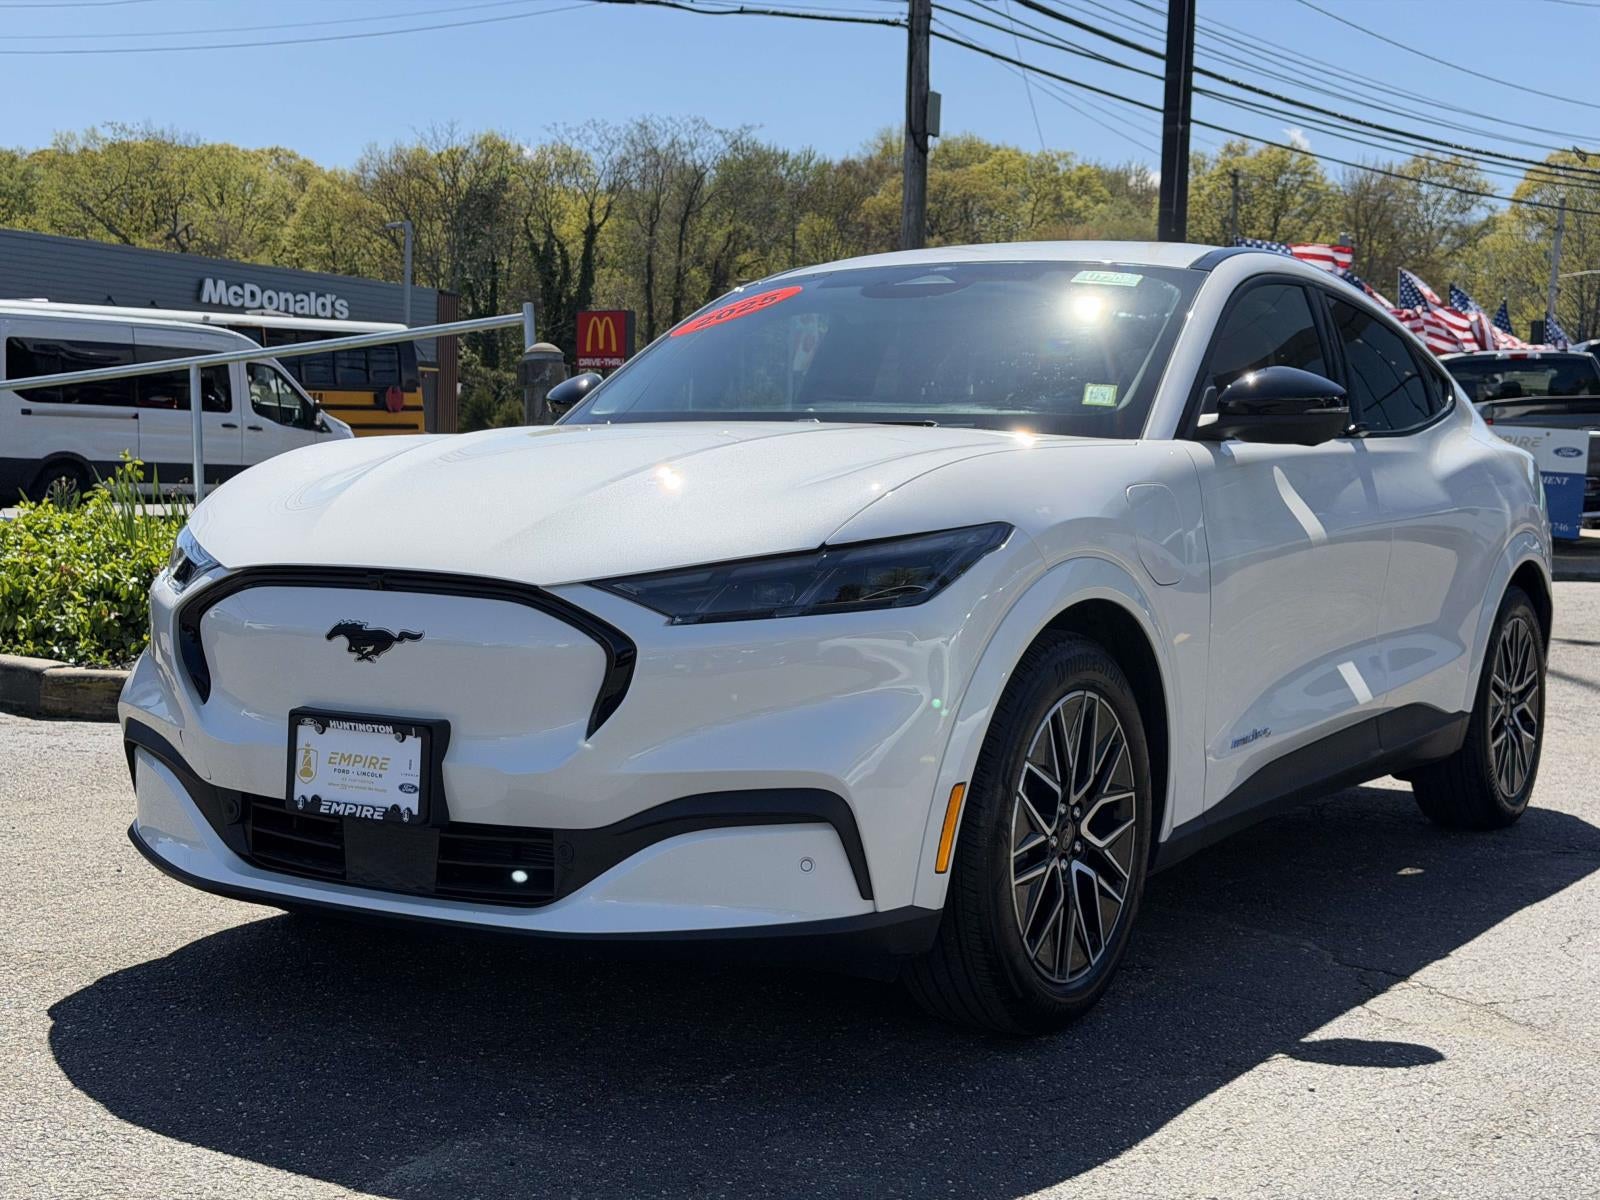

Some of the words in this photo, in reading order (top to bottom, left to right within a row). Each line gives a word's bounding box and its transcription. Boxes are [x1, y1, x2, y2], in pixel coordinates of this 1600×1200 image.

[201, 277, 350, 319] McDonald's
[694, 292, 782, 329] 2025
[578, 357, 625, 367] DRIVE-THRU
[1498, 434, 1543, 448] PIRE
[329, 720, 394, 735] HUNTINGTON
[328, 751, 391, 771] EMPIRE
[333, 767, 350, 775] FORD
[356, 770, 383, 779] LINCOLN
[401, 784, 416, 793] Ford
[319, 799, 386, 820] EMPIRE
